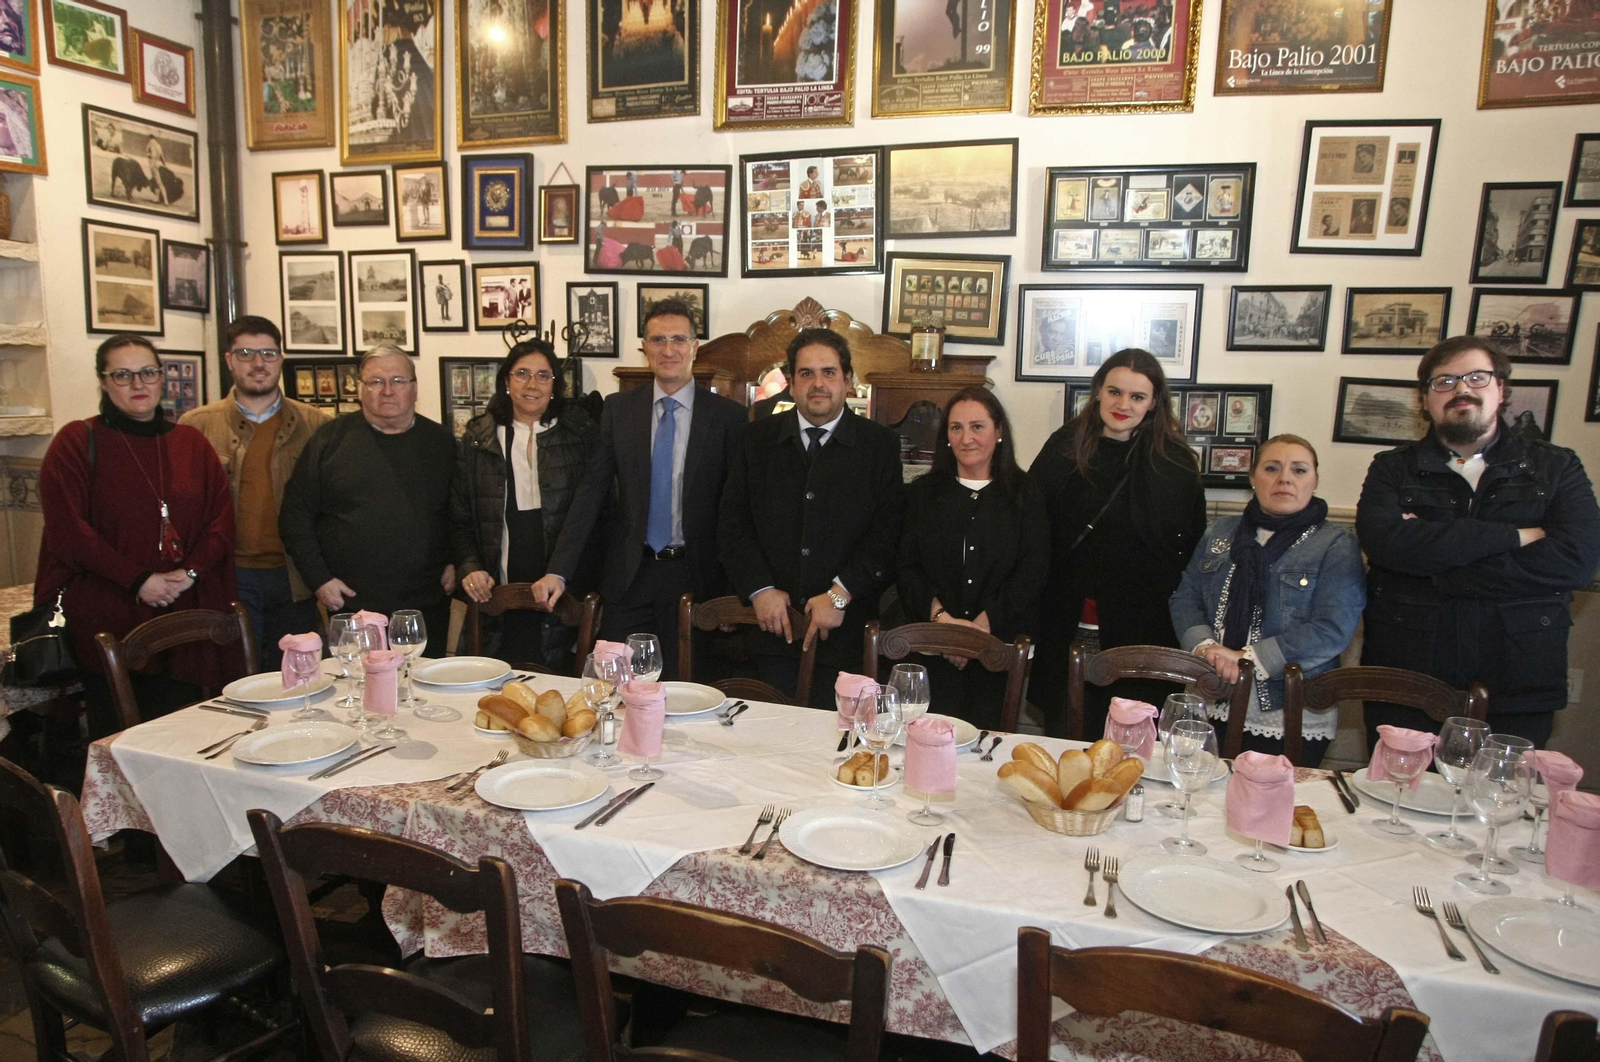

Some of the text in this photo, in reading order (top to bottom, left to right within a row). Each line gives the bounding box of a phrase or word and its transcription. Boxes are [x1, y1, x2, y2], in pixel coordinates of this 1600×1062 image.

[975, 44, 991, 55] 99
[1538, 42, 1580, 52] TERTULIA
[1062, 48, 1166, 63] BAJO PALIO 2000
[1228, 43, 1377, 74] Bajo Palio 2001
[1300, 66, 1334, 77] Concepción
[1496, 57, 1545, 76] BAJO
[1034, 350, 1056, 362] CUBA
[1047, 349, 1075, 365] ESPAÑA
